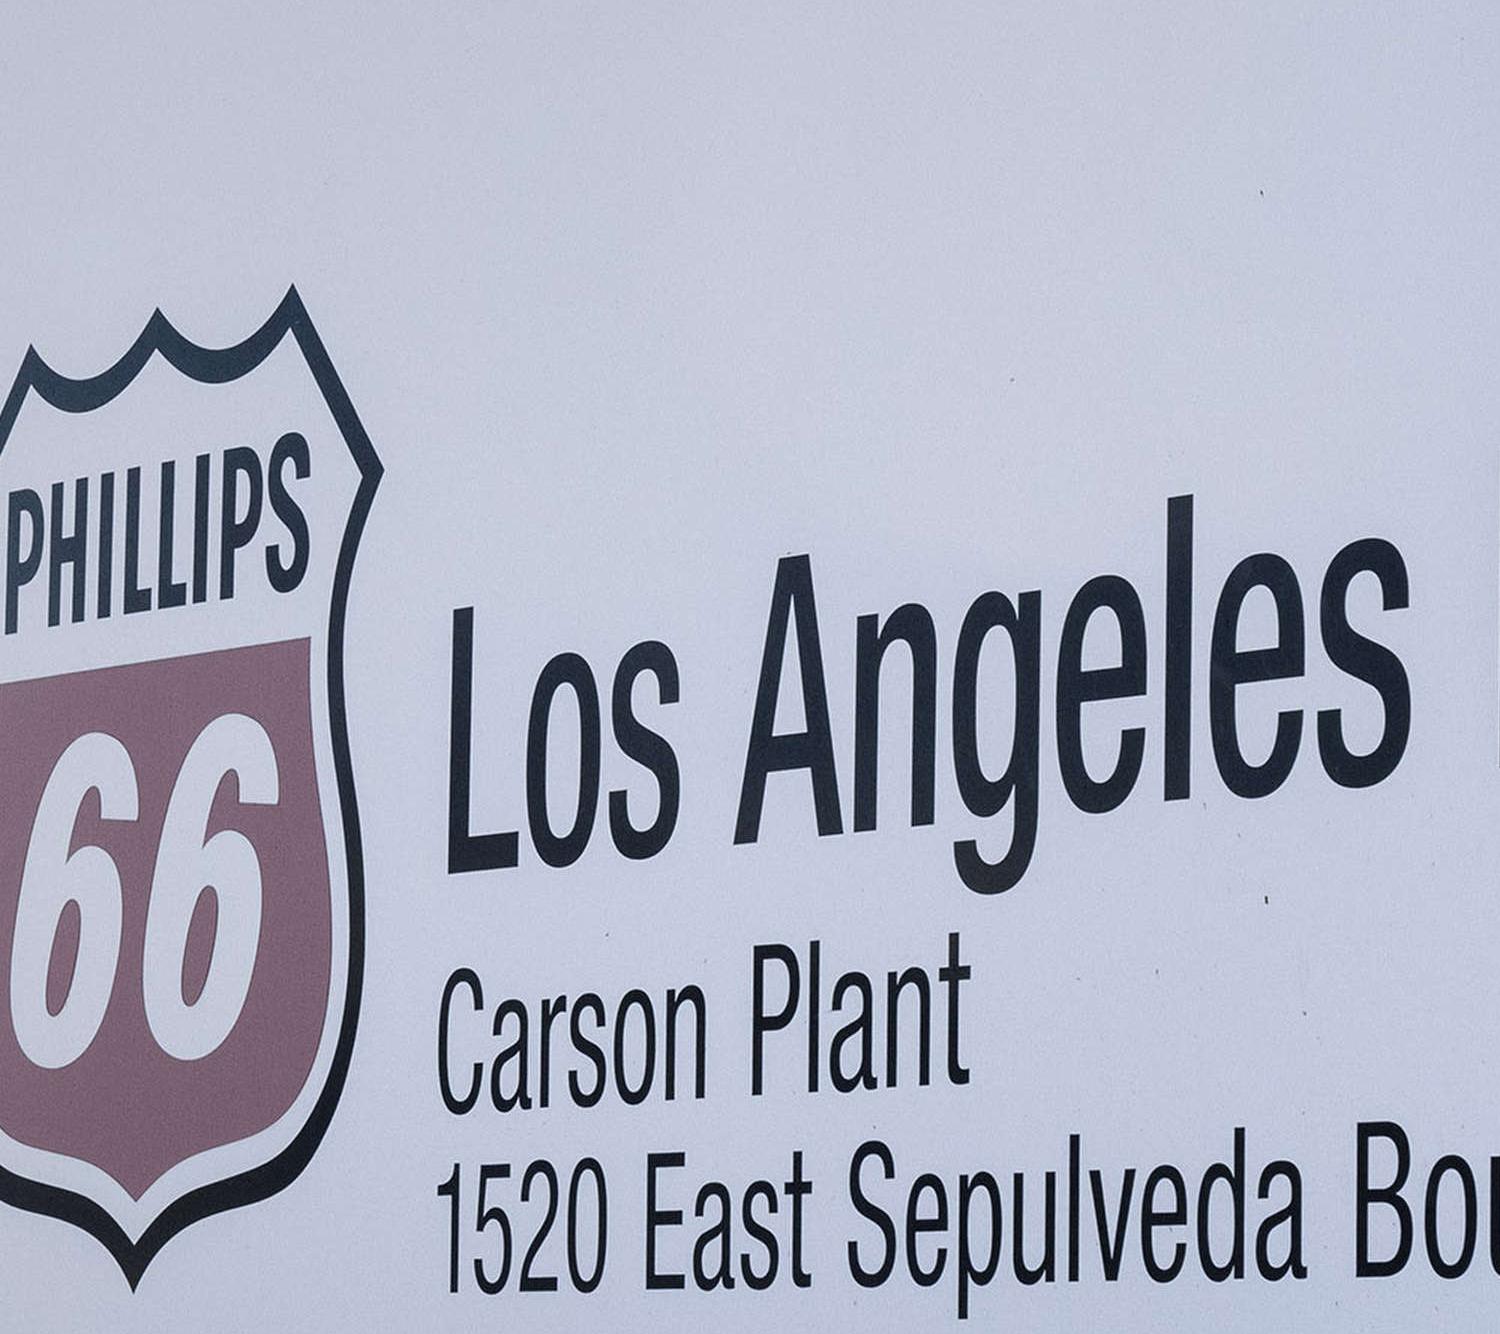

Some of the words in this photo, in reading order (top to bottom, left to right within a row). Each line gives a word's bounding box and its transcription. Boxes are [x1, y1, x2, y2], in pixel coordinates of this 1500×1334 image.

[3, 431, 312, 637] PHILLIPS
[446, 605, 681, 876] Los
[732, 492, 1412, 896] Angeles
[8, 712, 280, 1070] 66
[437, 966, 707, 1117] Carson
[750, 931, 972, 1097] Plant
[436, 1156, 609, 1296] 1520
[644, 1149, 814, 1293] East
[846, 1125, 1309, 1321] Sepulveda
